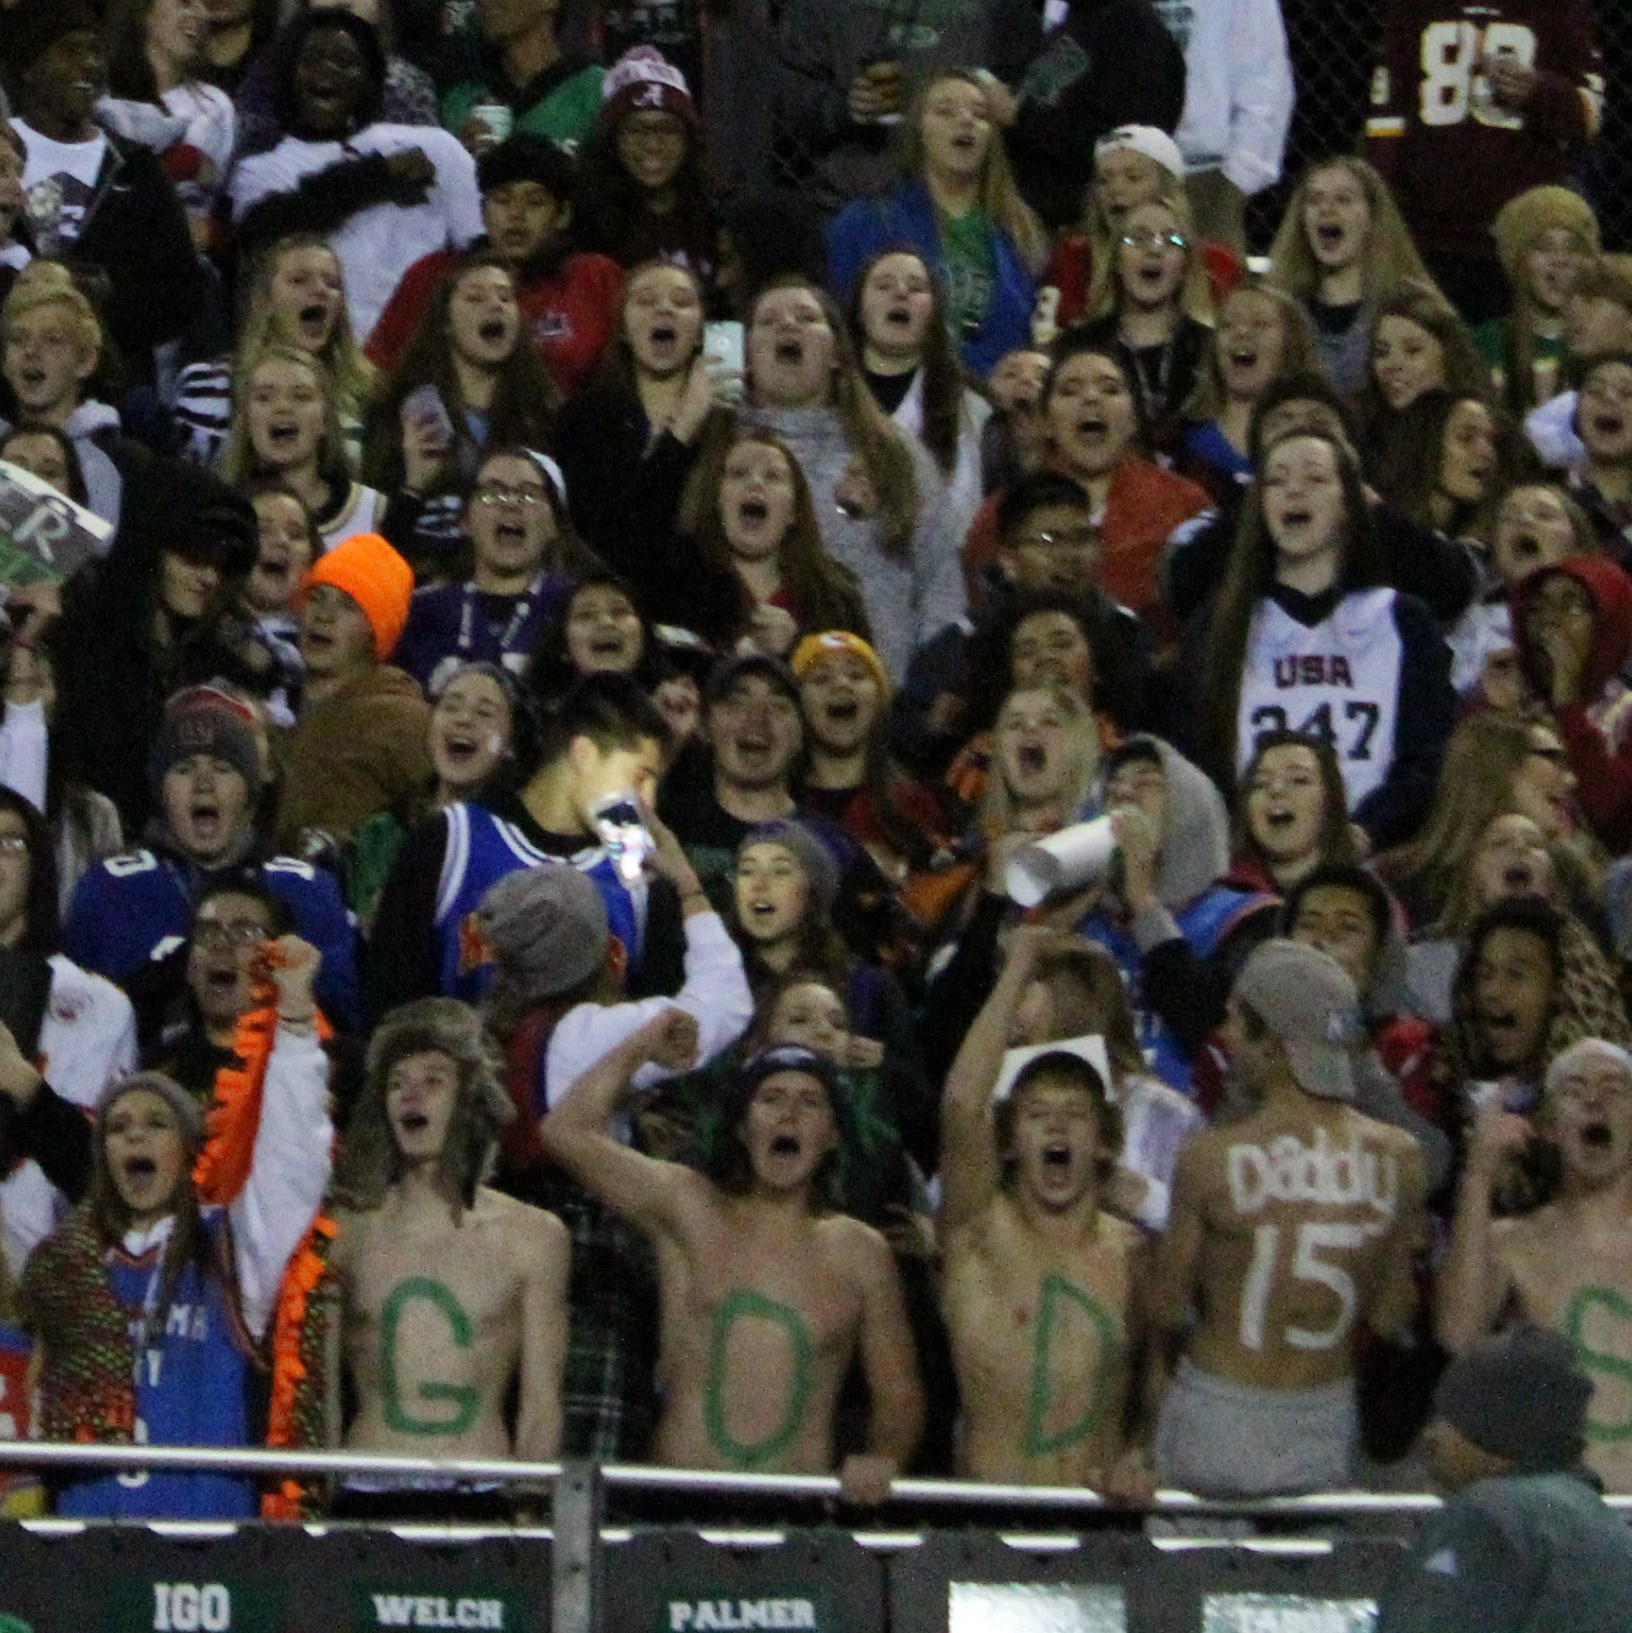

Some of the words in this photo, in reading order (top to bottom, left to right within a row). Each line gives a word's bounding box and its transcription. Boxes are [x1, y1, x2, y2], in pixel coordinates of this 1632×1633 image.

[1271, 655, 1351, 689] USA
[1239, 1222, 1367, 1351] 15
[381, 1276, 480, 1436] G
[1025, 1274, 1115, 1457] D
[153, 1581, 231, 1631] IGO
[372, 1593, 504, 1629] WELCH
[668, 1598, 815, 1632] PALMER
